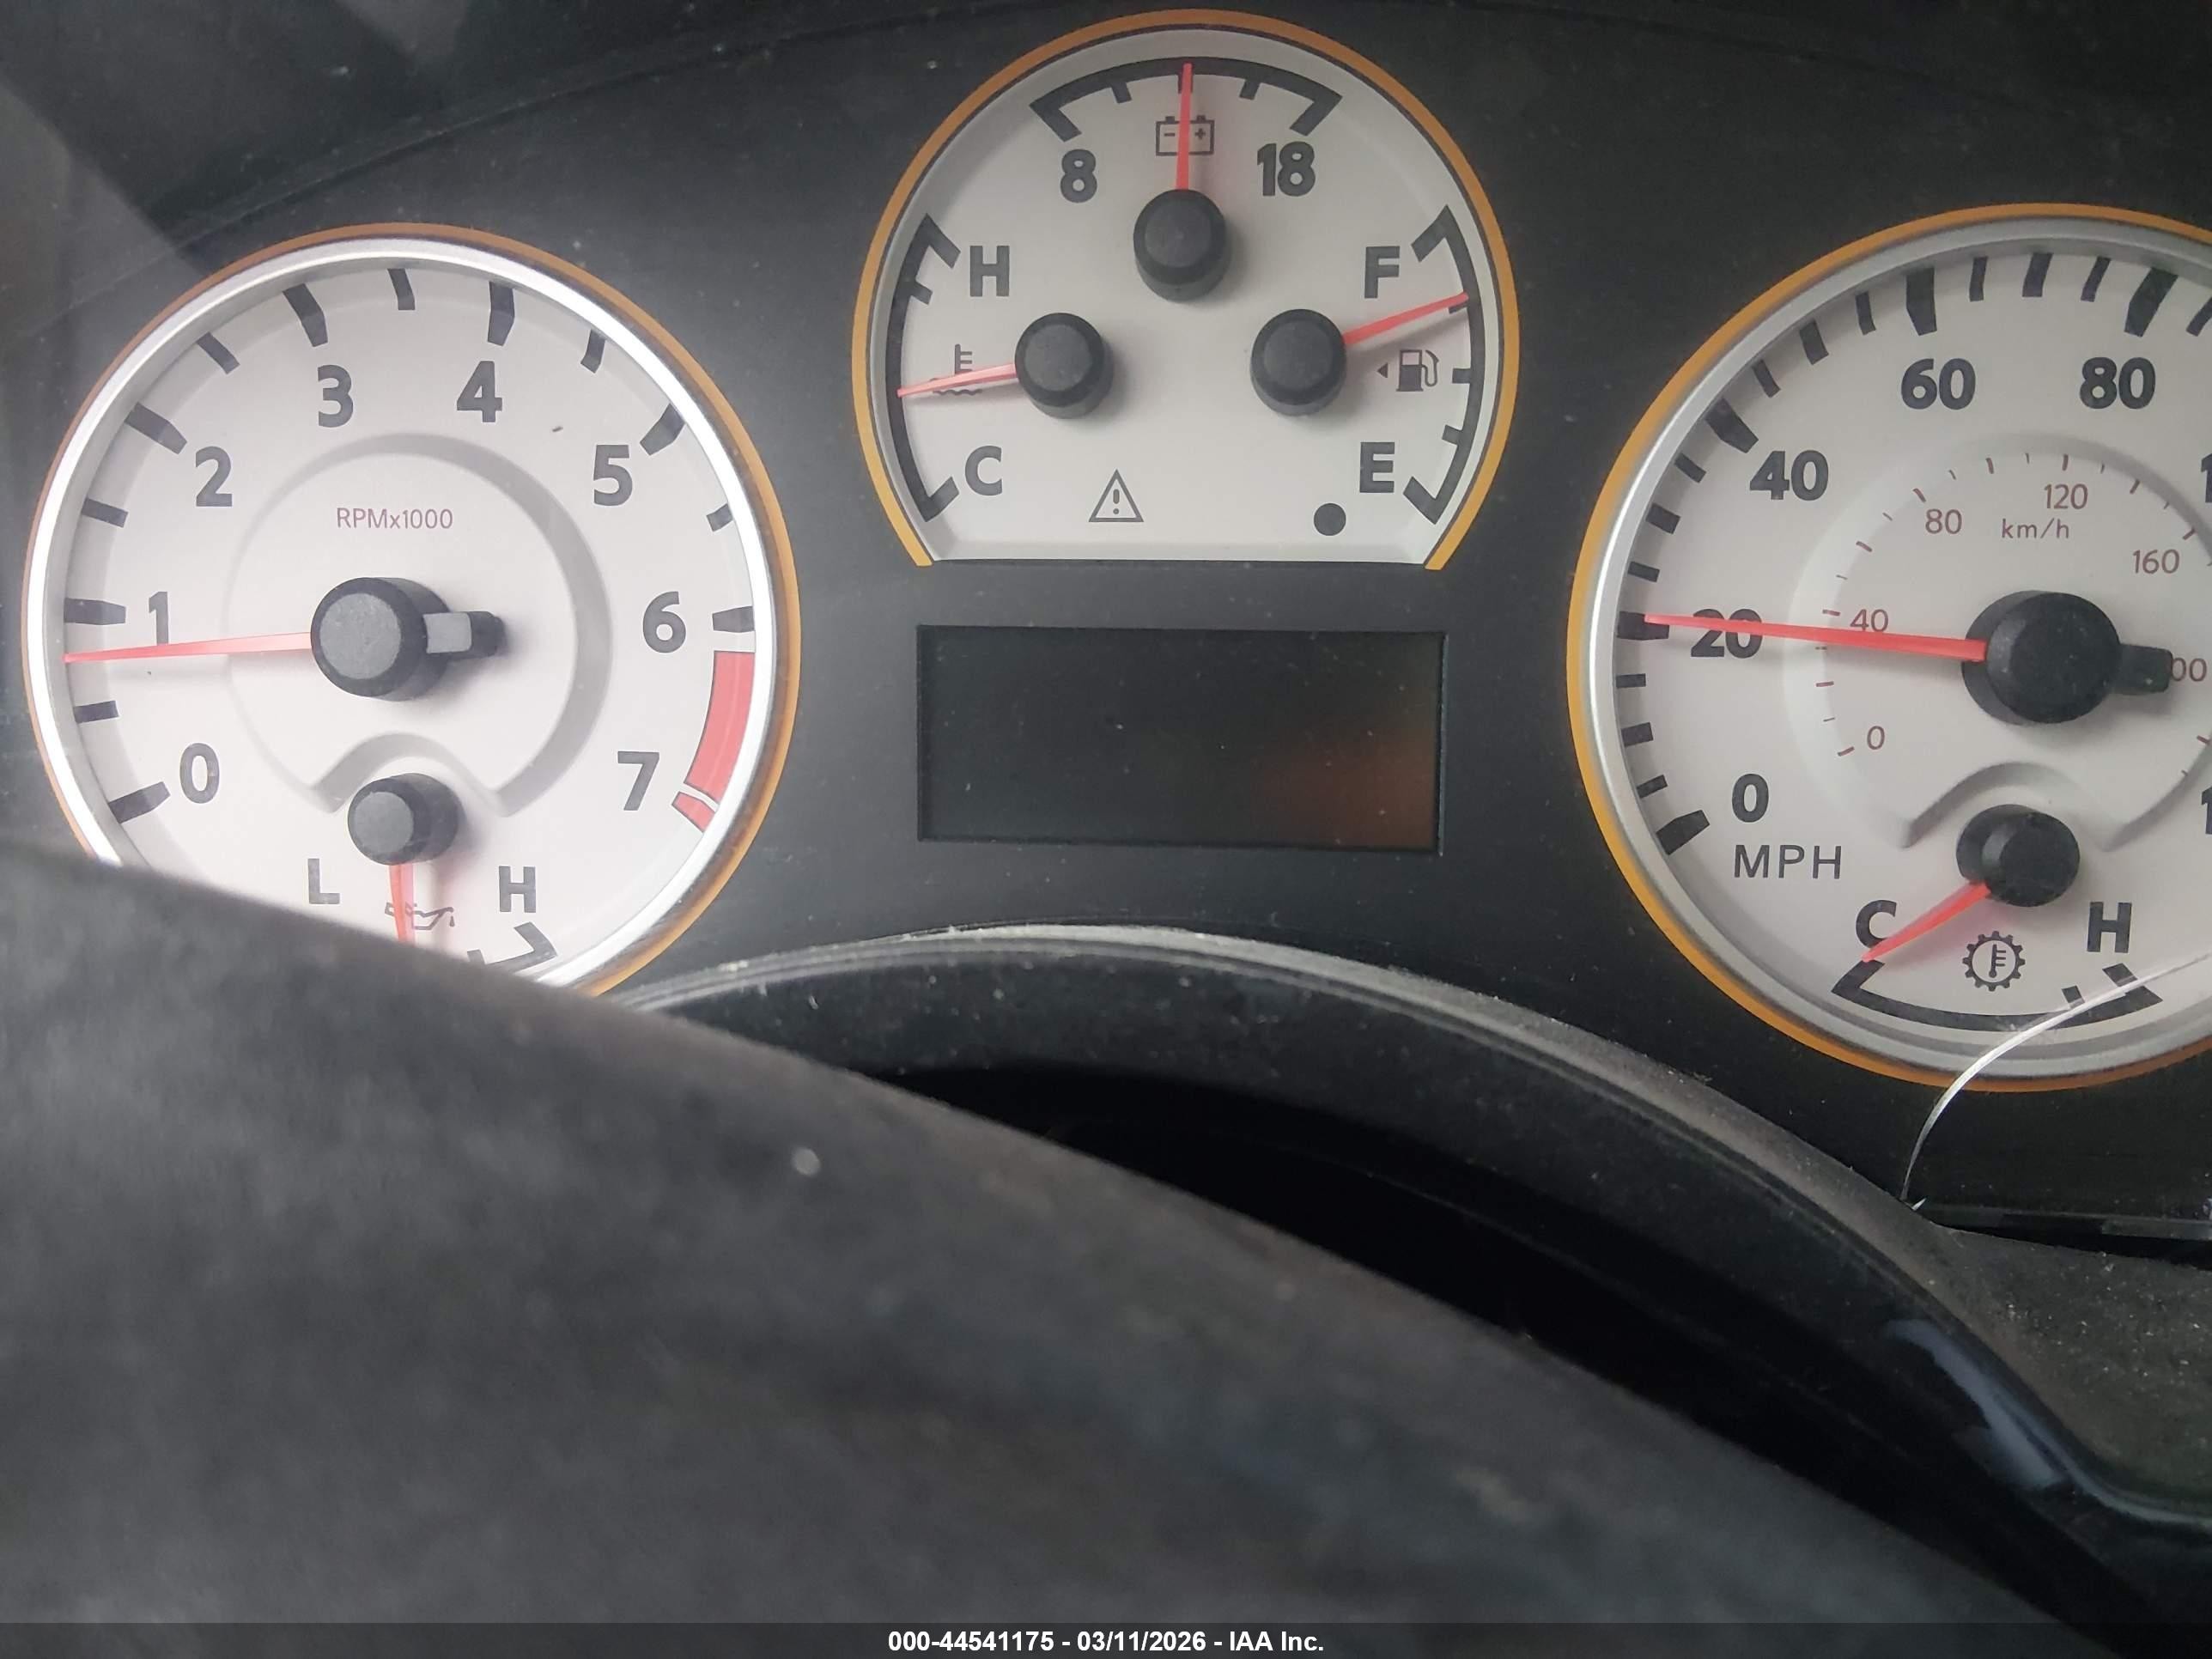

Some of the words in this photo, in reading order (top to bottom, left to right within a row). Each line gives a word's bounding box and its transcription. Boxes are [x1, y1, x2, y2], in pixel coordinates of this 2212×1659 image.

[1060, 149, 1097, 203] 8
[1257, 141, 1316, 196] 18
[969, 246, 1010, 296] H
[1364, 246, 1401, 298] F
[318, 367, 353, 427] 3
[457, 361, 502, 422] 4
[1900, 357, 1975, 410] 60
[2080, 357, 2156, 409] 80
[195, 447, 233, 507] 2
[593, 445, 633, 508] 5
[964, 446, 1003, 495] C
[1359, 441, 1395, 492] E
[1750, 449, 1829, 500] 40
[336, 507, 453, 531] RPMx1000
[1925, 509, 1963, 534] 80
[2045, 483, 2088, 510] 120
[2002, 519, 2070, 540] km/h
[2133, 550, 2180, 574] 160
[148, 592, 169, 645] 1
[642, 592, 686, 653] 6
[1691, 608, 1763, 658] 20
[1850, 609, 1889, 633] 40
[2170, 658, 2208, 682] 00
[1866, 726, 1886, 750] 0
[179, 743, 220, 803] 0
[617, 751, 660, 811] 7
[1732, 774, 1769, 823] 0
[308, 859, 340, 904] L
[1734, 844, 1843, 879] MPH
[499, 866, 537, 912] H
[1856, 900, 1897, 945] C
[2087, 902, 2132, 952] H
